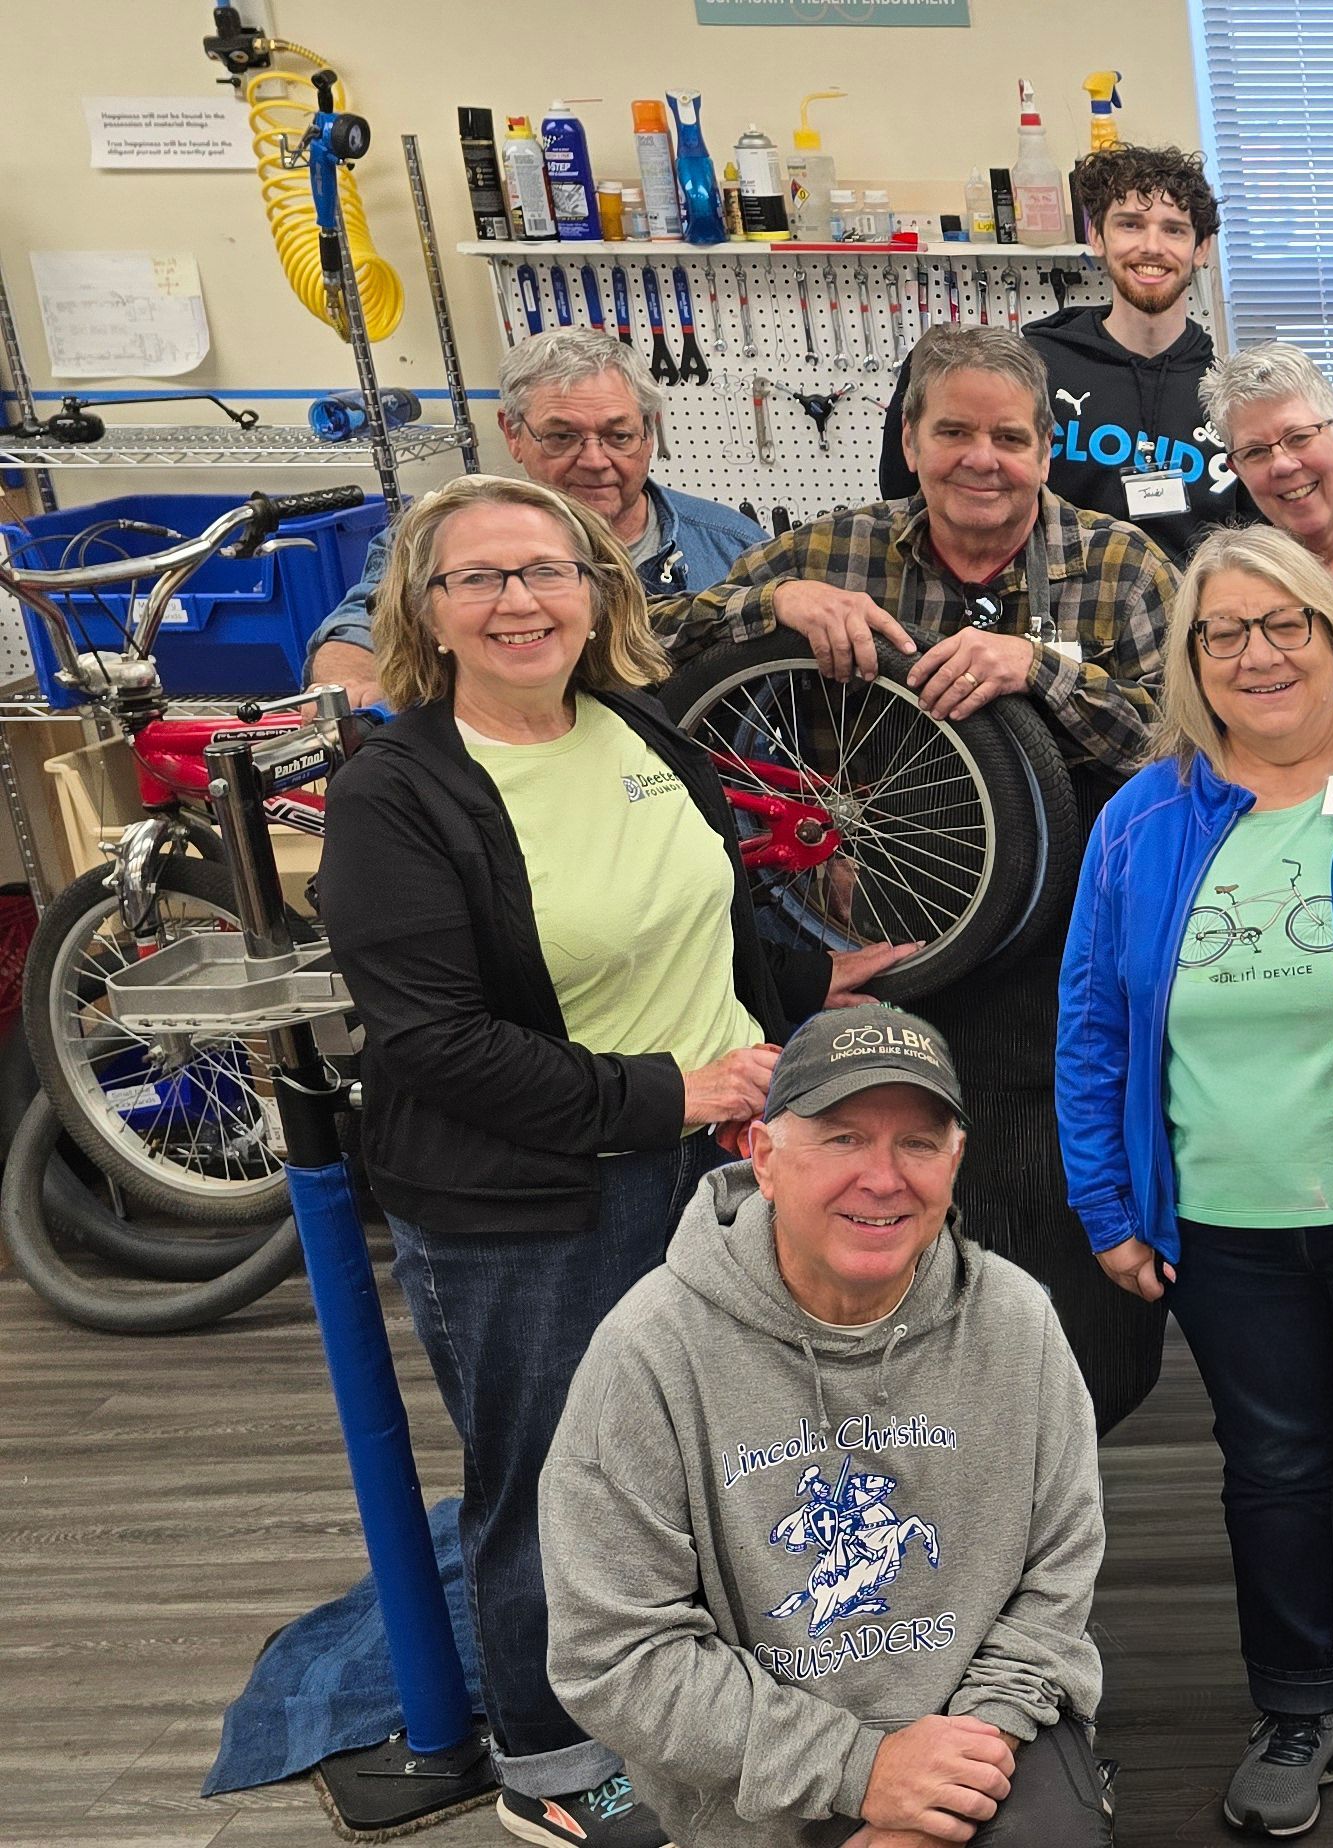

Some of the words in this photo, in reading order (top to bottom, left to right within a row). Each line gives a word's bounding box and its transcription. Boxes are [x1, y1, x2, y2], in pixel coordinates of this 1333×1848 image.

[274, 759, 302, 779] Park
[301, 749, 325, 767] Tool
[1263, 965, 1313, 979] DEVICE
[886, 1026, 935, 1055] LBK
[830, 1046, 876, 1062] LINCOLN
[878, 1046, 901, 1055] BIKE
[903, 1048, 940, 1068] KITCHEN
[836, 1414, 957, 1452] Christian
[754, 1612, 956, 1681] CRUSADERS
